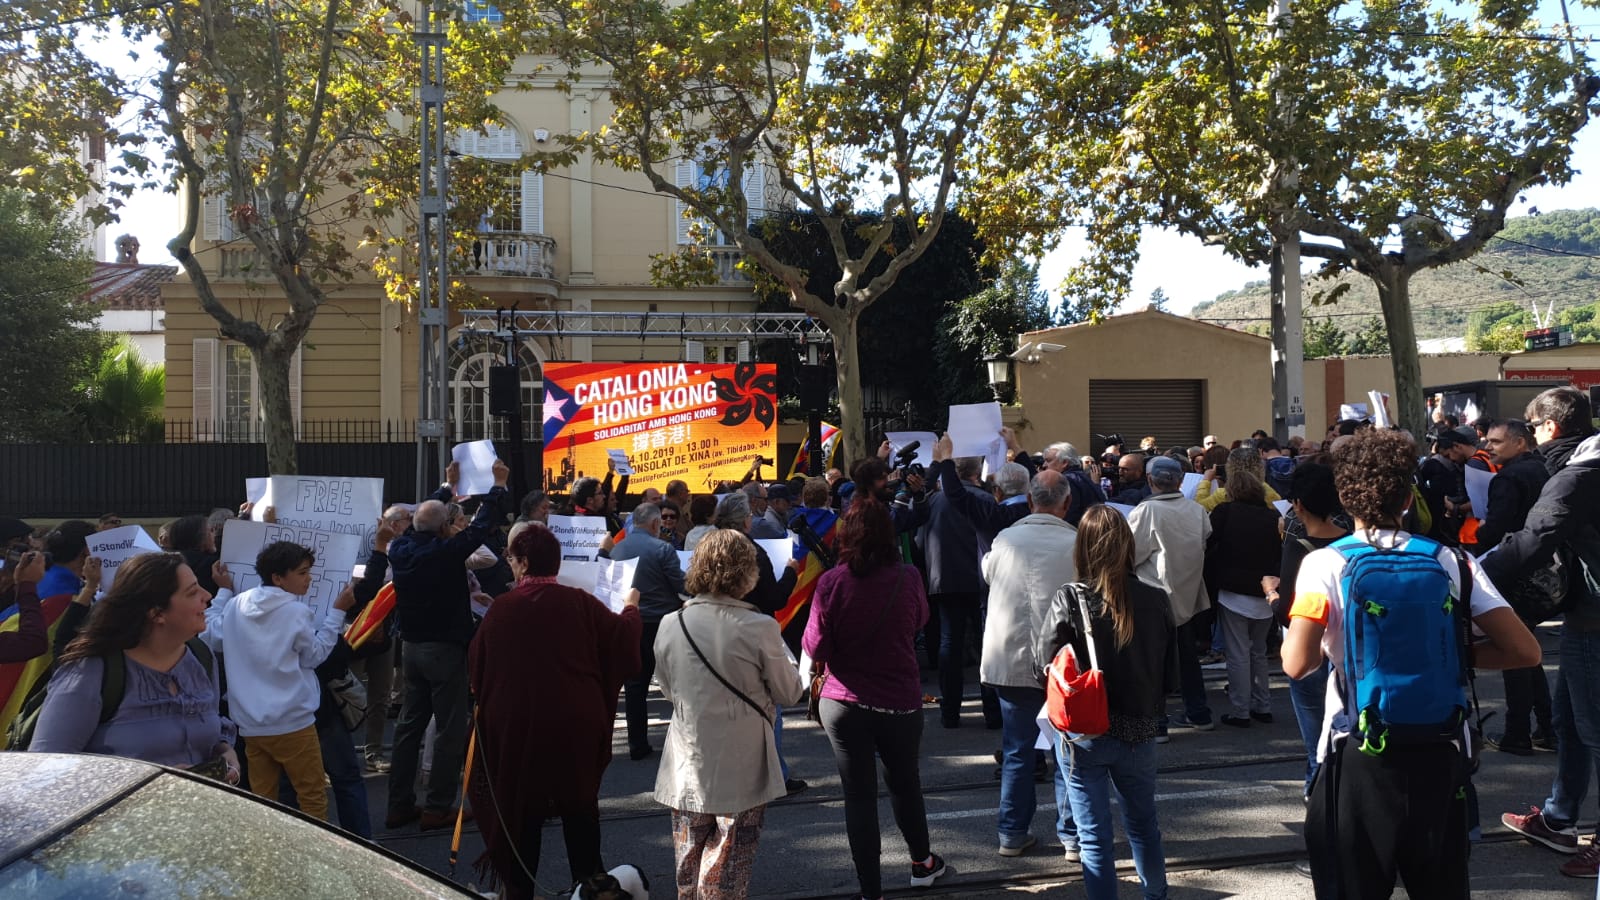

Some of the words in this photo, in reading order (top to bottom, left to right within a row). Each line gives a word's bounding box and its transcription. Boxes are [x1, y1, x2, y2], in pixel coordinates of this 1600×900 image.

[574, 363, 688, 405] CATALONIA
[593, 394, 653, 426] HONG
[660, 381, 717, 413] KONG
[593, 421, 647, 441] SOLIDARITAT
[648, 416, 668, 430] AMB
[668, 411, 692, 425] HONG
[694, 406, 718, 420] KONG
[713, 437, 719, 446] h
[630, 467, 689, 485] StandUpForCatalonia
[631, 457, 672, 474] ONSOLAT
[674, 454, 687, 466] DE
[688, 450, 711, 463] XINA
[296, 480, 352, 515] FREE
